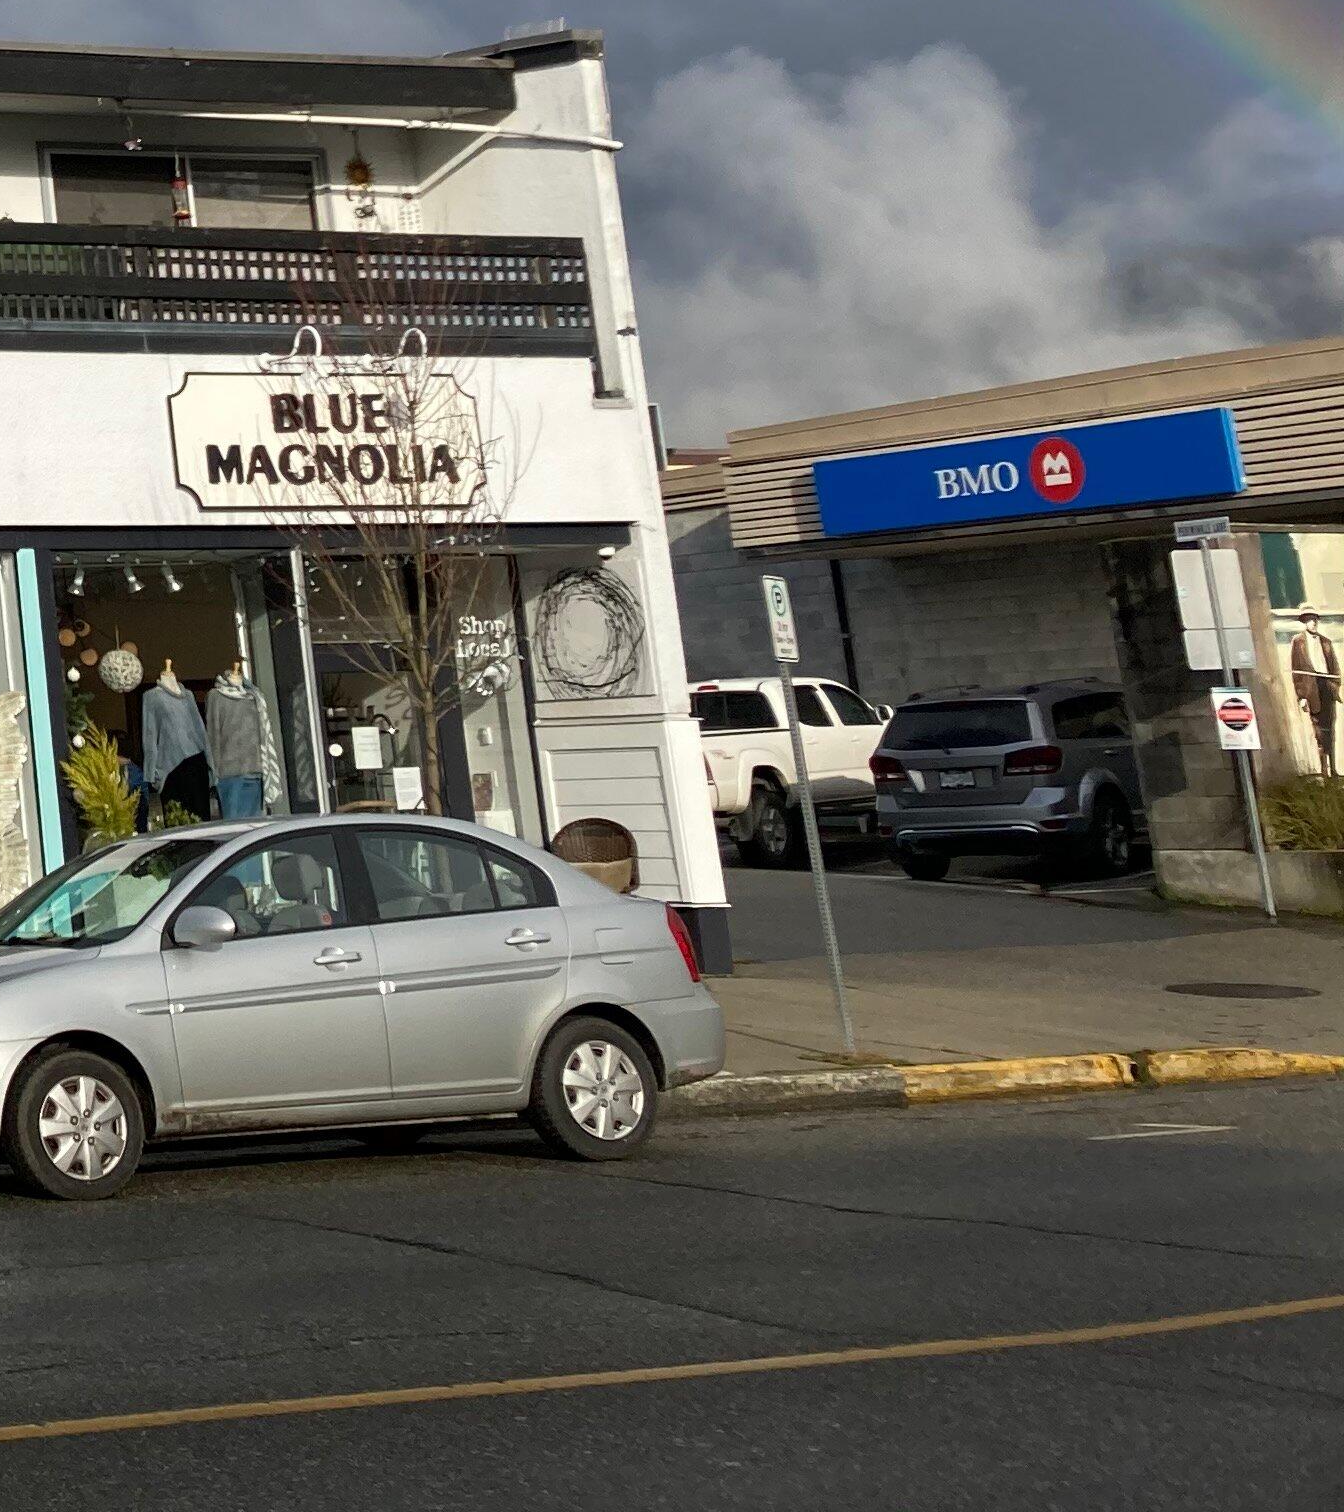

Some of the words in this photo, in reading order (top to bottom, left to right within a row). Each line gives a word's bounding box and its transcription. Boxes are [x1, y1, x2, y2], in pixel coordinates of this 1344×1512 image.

[270, 393, 389, 433] BLUE
[206, 444, 461, 485] MAGNOLIA
[933, 461, 1020, 500] BMO
[458, 615, 507, 638] Shop
[456, 639, 511, 658] Local
